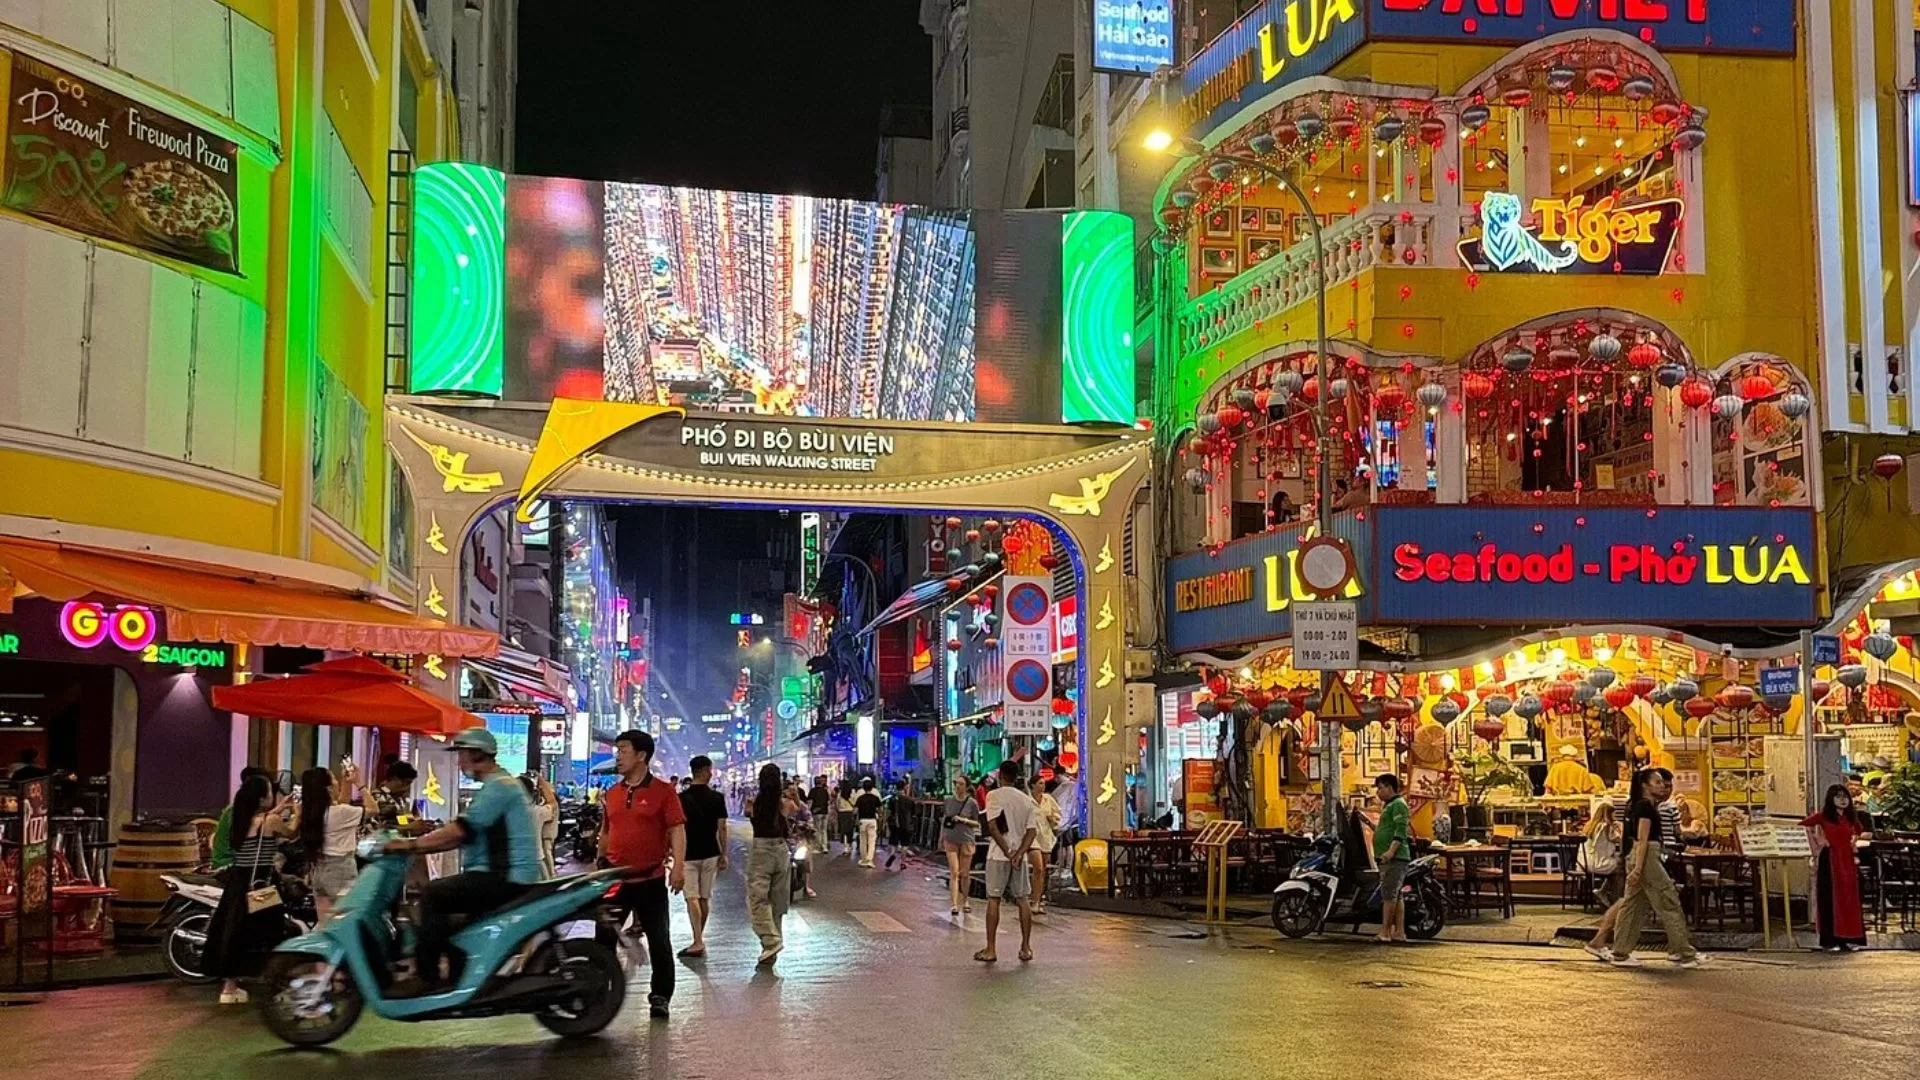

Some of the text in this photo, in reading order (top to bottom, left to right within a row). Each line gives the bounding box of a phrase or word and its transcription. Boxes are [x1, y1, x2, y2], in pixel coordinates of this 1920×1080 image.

[1098, 0, 1169, 23] Seafood
[18, 88, 111, 149] Discount
[127, 107, 230, 174] Firewood Pizza
[1531, 194, 1662, 263] Tiger
[681, 422, 894, 456] PHỐ ĐI BỘ BÙI VIỆN
[700, 452, 877, 471] BUI VIEN WALKING STREET
[1393, 542, 1574, 583] Seafood
[1609, 541, 1698, 585] Phở
[1702, 535, 1811, 584] LÚA
[1175, 567, 1255, 613] RESTAURANT
[66, 602, 151, 646] GO
